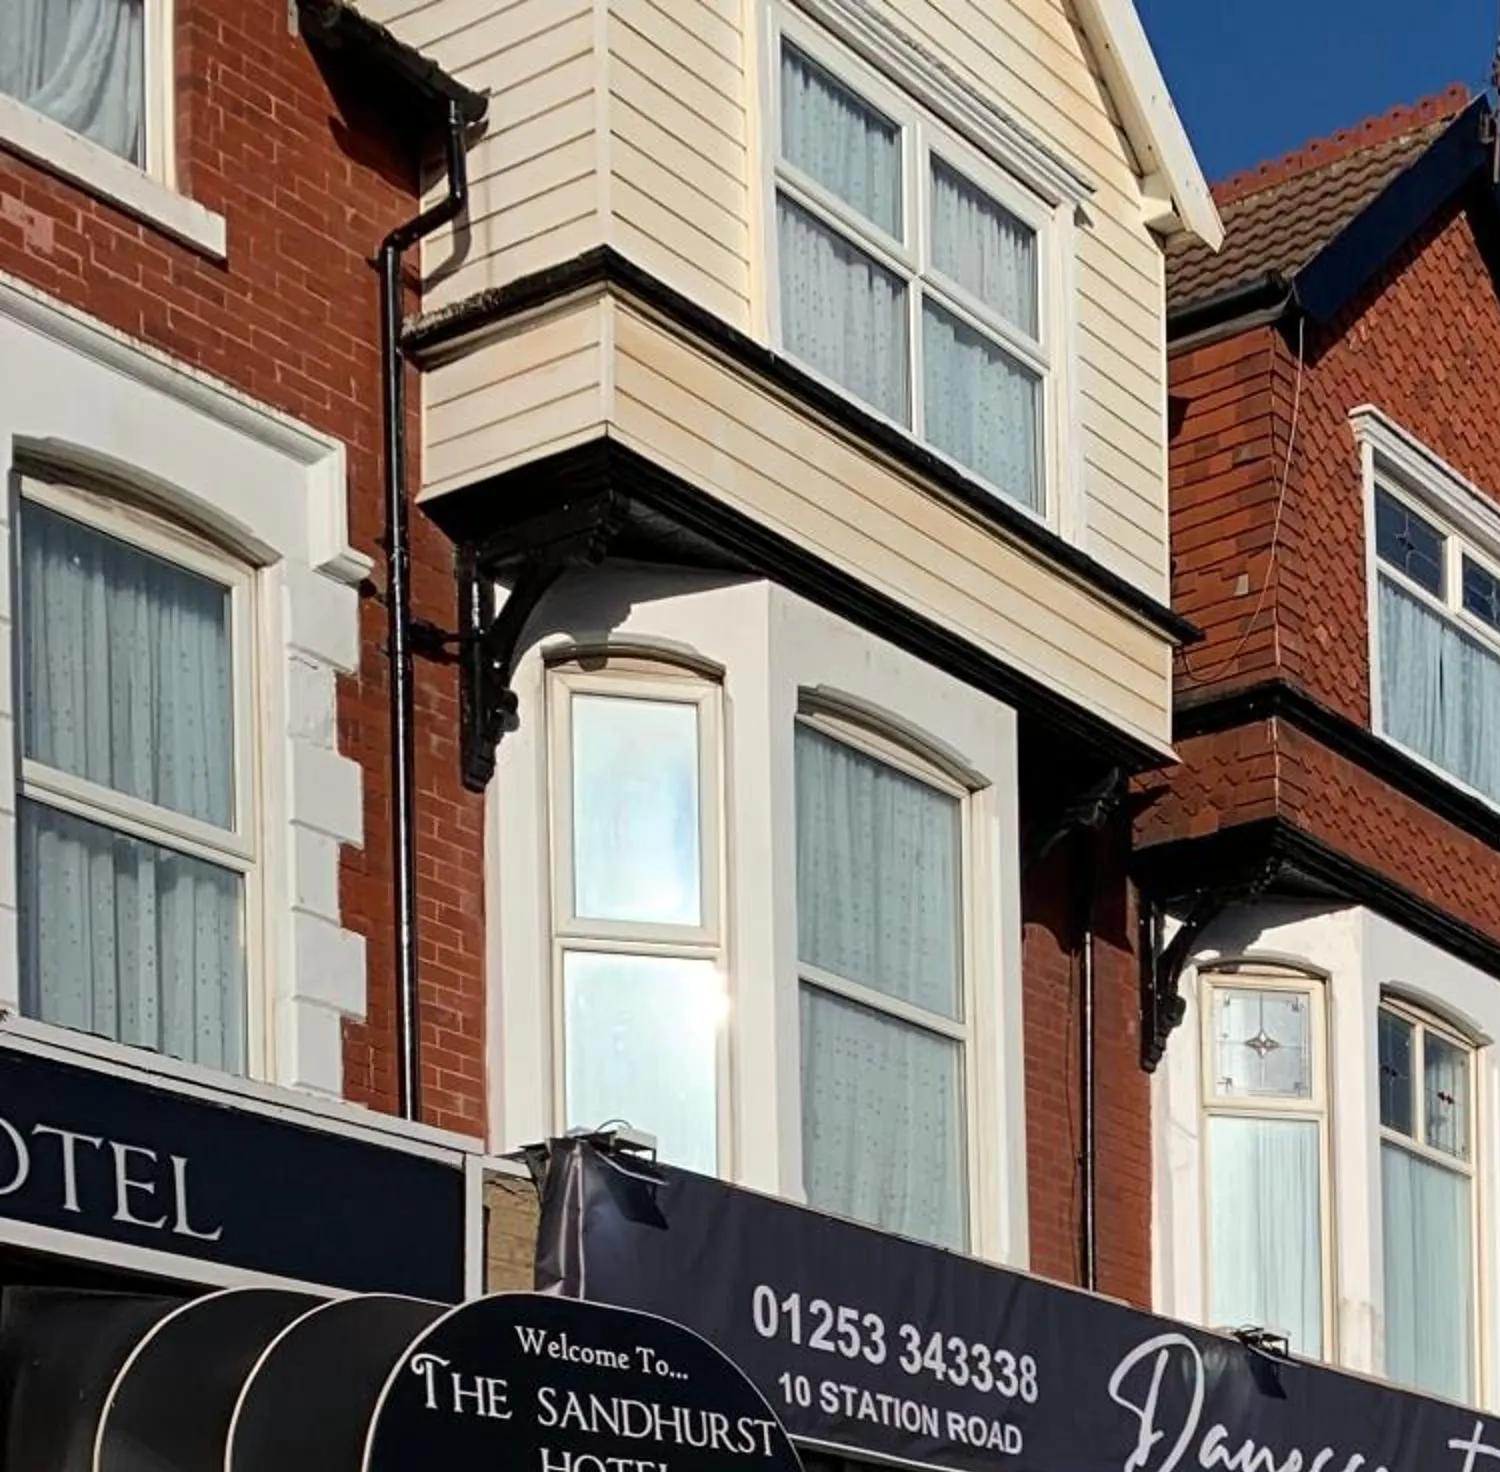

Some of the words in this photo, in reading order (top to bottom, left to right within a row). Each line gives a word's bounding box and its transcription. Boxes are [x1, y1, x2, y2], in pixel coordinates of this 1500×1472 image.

[513, 1325, 631, 1370] Welcome
[635, 1346, 690, 1381] To...
[752, 1284, 888, 1366] 01253
[899, 1322, 1040, 1404] 343338
[410, 1353, 513, 1420] THE
[536, 1386, 777, 1457] SANDHURST
[777, 1371, 812, 1408] 10
[819, 1381, 940, 1438] STATION
[945, 1411, 1024, 1455] ROAD
